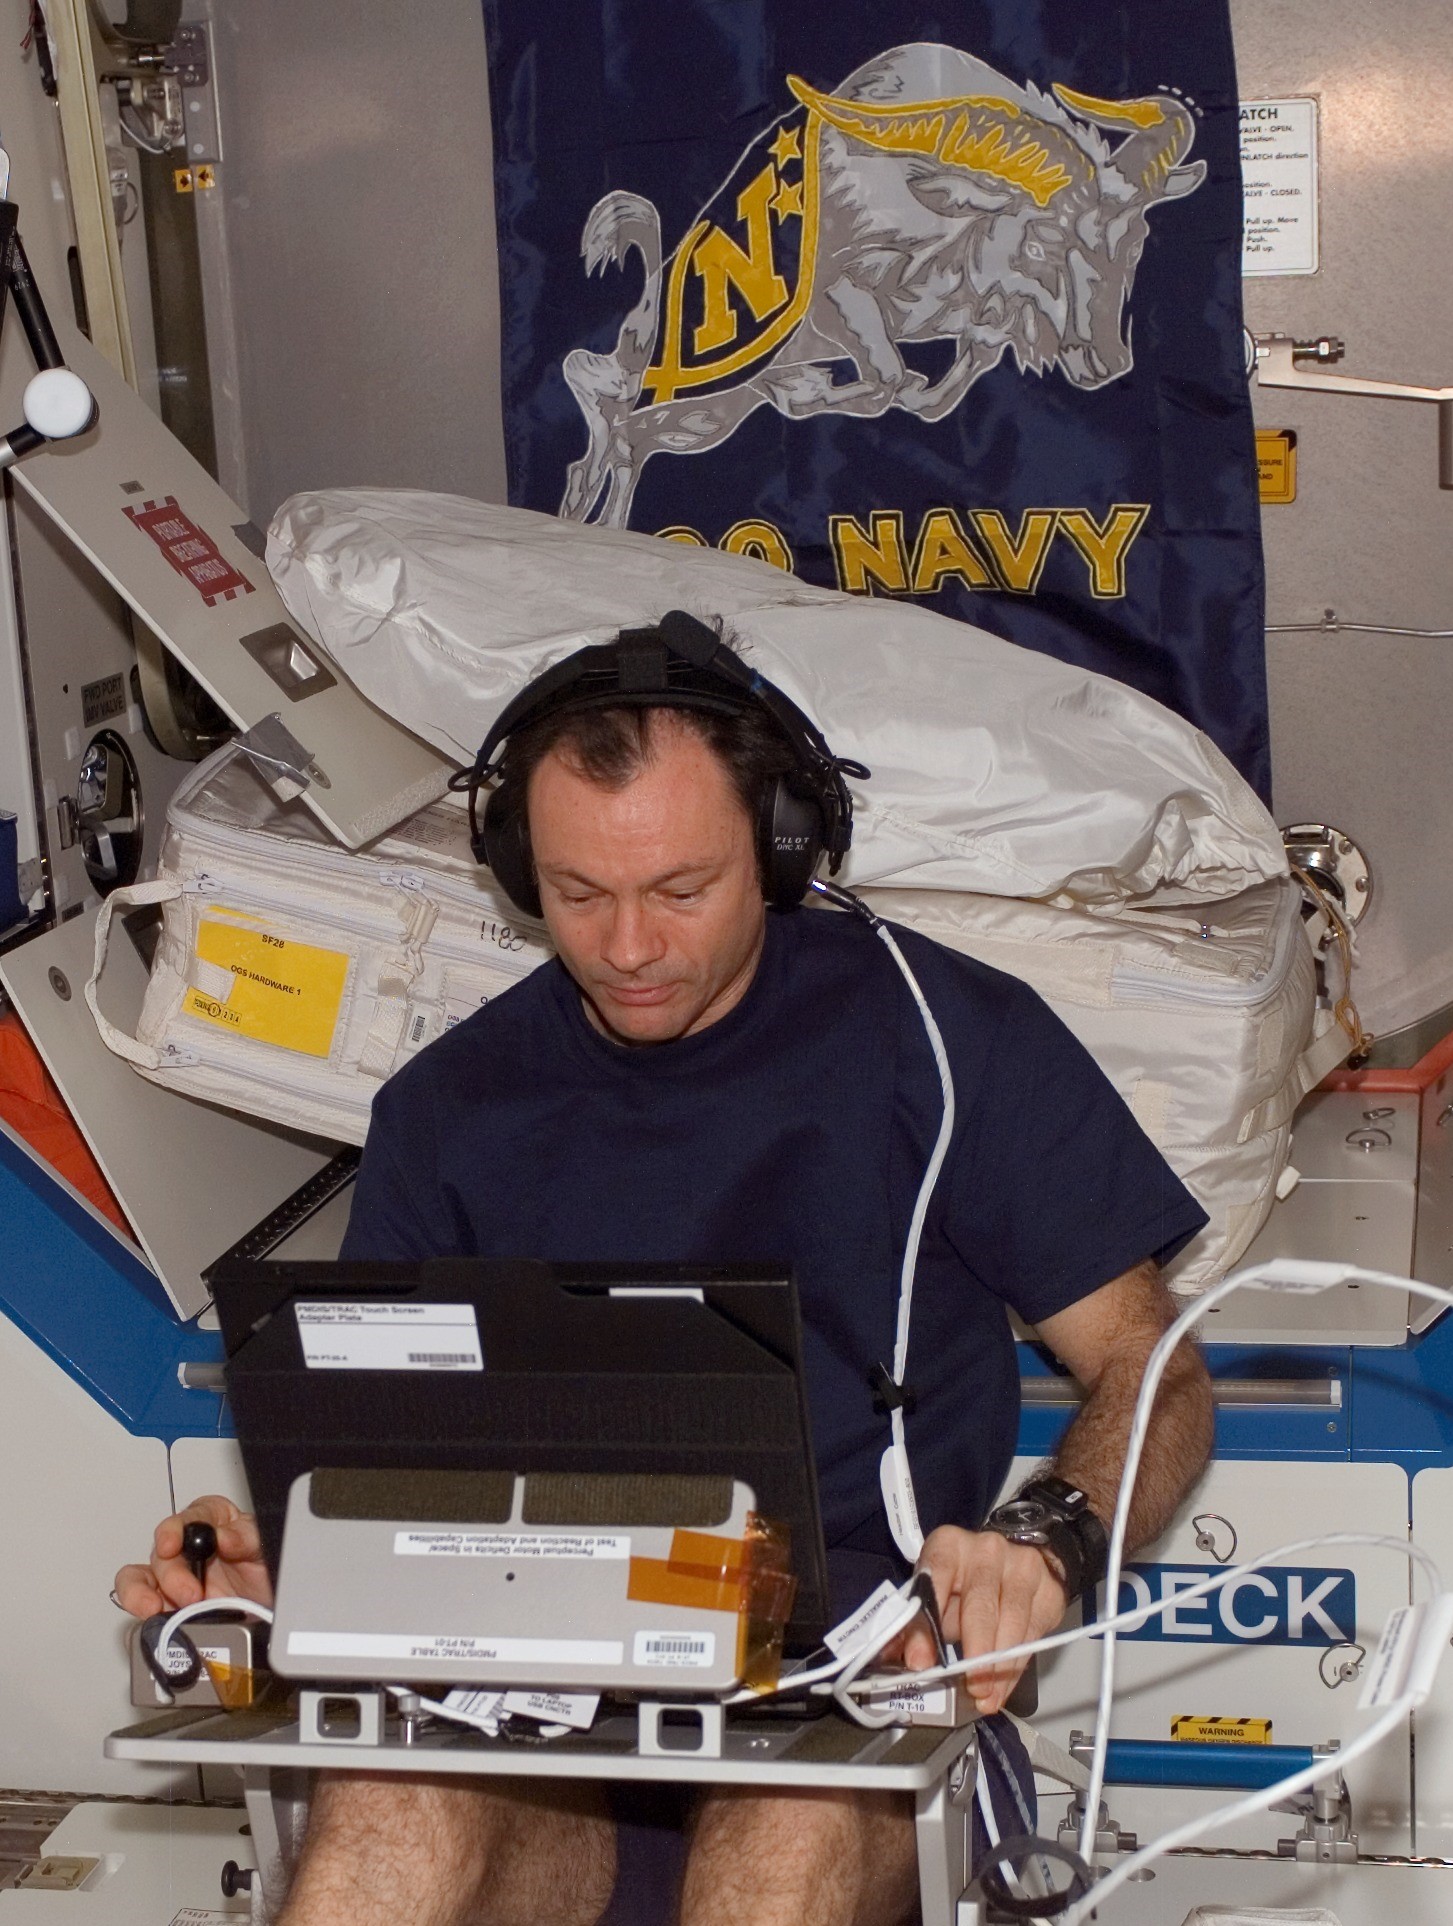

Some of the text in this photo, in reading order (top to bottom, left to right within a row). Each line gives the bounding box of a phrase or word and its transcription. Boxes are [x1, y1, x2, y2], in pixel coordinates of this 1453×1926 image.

[693, 161, 790, 356] N
[828, 504, 1151, 598] NAVY
[84, 676, 123, 704] FWD PORT
[100, 695, 124, 716] VALVE
[774, 836, 810, 844] PILOT
[249, 972, 294, 994] HARDWARE
[360, 1306, 390, 1314] Touch
[299, 1314, 336, 1323] Adapter
[409, 1535, 617, 1547] Test of Reaction and Adaptation Capabilities
[475, 1545, 511, 1554] Deficits
[513, 1546, 541, 1555] Motor
[543, 1547, 594, 1556] Perceptual
[1096, 1570, 1349, 1640] DECK
[410, 1647, 439, 1657] TABLE
[889, 1701, 925, 1711] P/N T-10
[1198, 1727, 1245, 1736] WARNING
